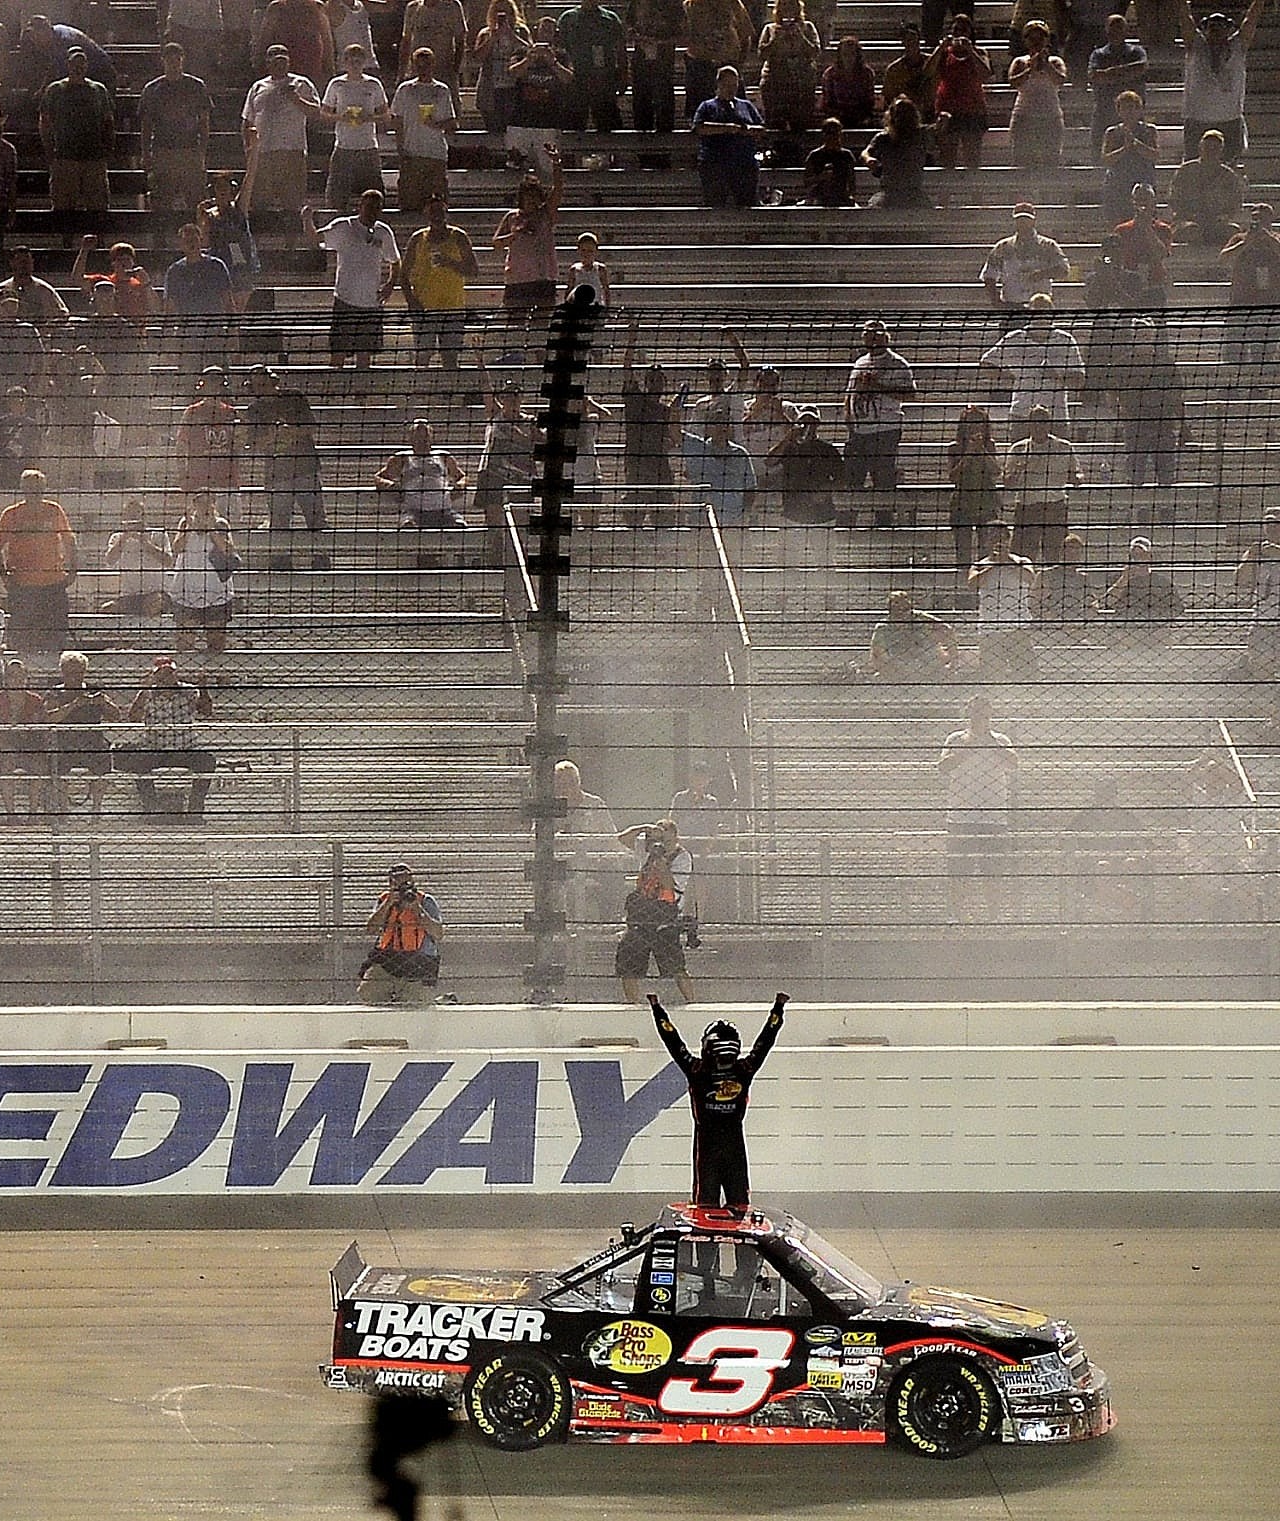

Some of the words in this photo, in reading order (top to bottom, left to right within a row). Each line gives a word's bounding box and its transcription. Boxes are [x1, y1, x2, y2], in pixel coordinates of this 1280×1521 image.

[353, 1301, 546, 1342] TRACKER
[620, 1322, 655, 1338] Bass
[358, 1335, 470, 1362] BOATS
[621, 1337, 646, 1352] Pro
[913, 1343, 978, 1361] GOODYEAR
[620, 1350, 662, 1369] Shops
[375, 1371, 421, 1387] ARCTIC
[422, 1374, 446, 1388] CAT
[658, 1327, 795, 1416] 3
[471, 1358, 504, 1435] GOODYEAR
[844, 1380, 873, 1391] MSD
[537, 1375, 562, 1438] WRANGLER
[960, 1367, 989, 1432] WRANGLER
[1068, 1396, 1086, 1413] 3
[898, 1378, 938, 1453] GOODYEAR
